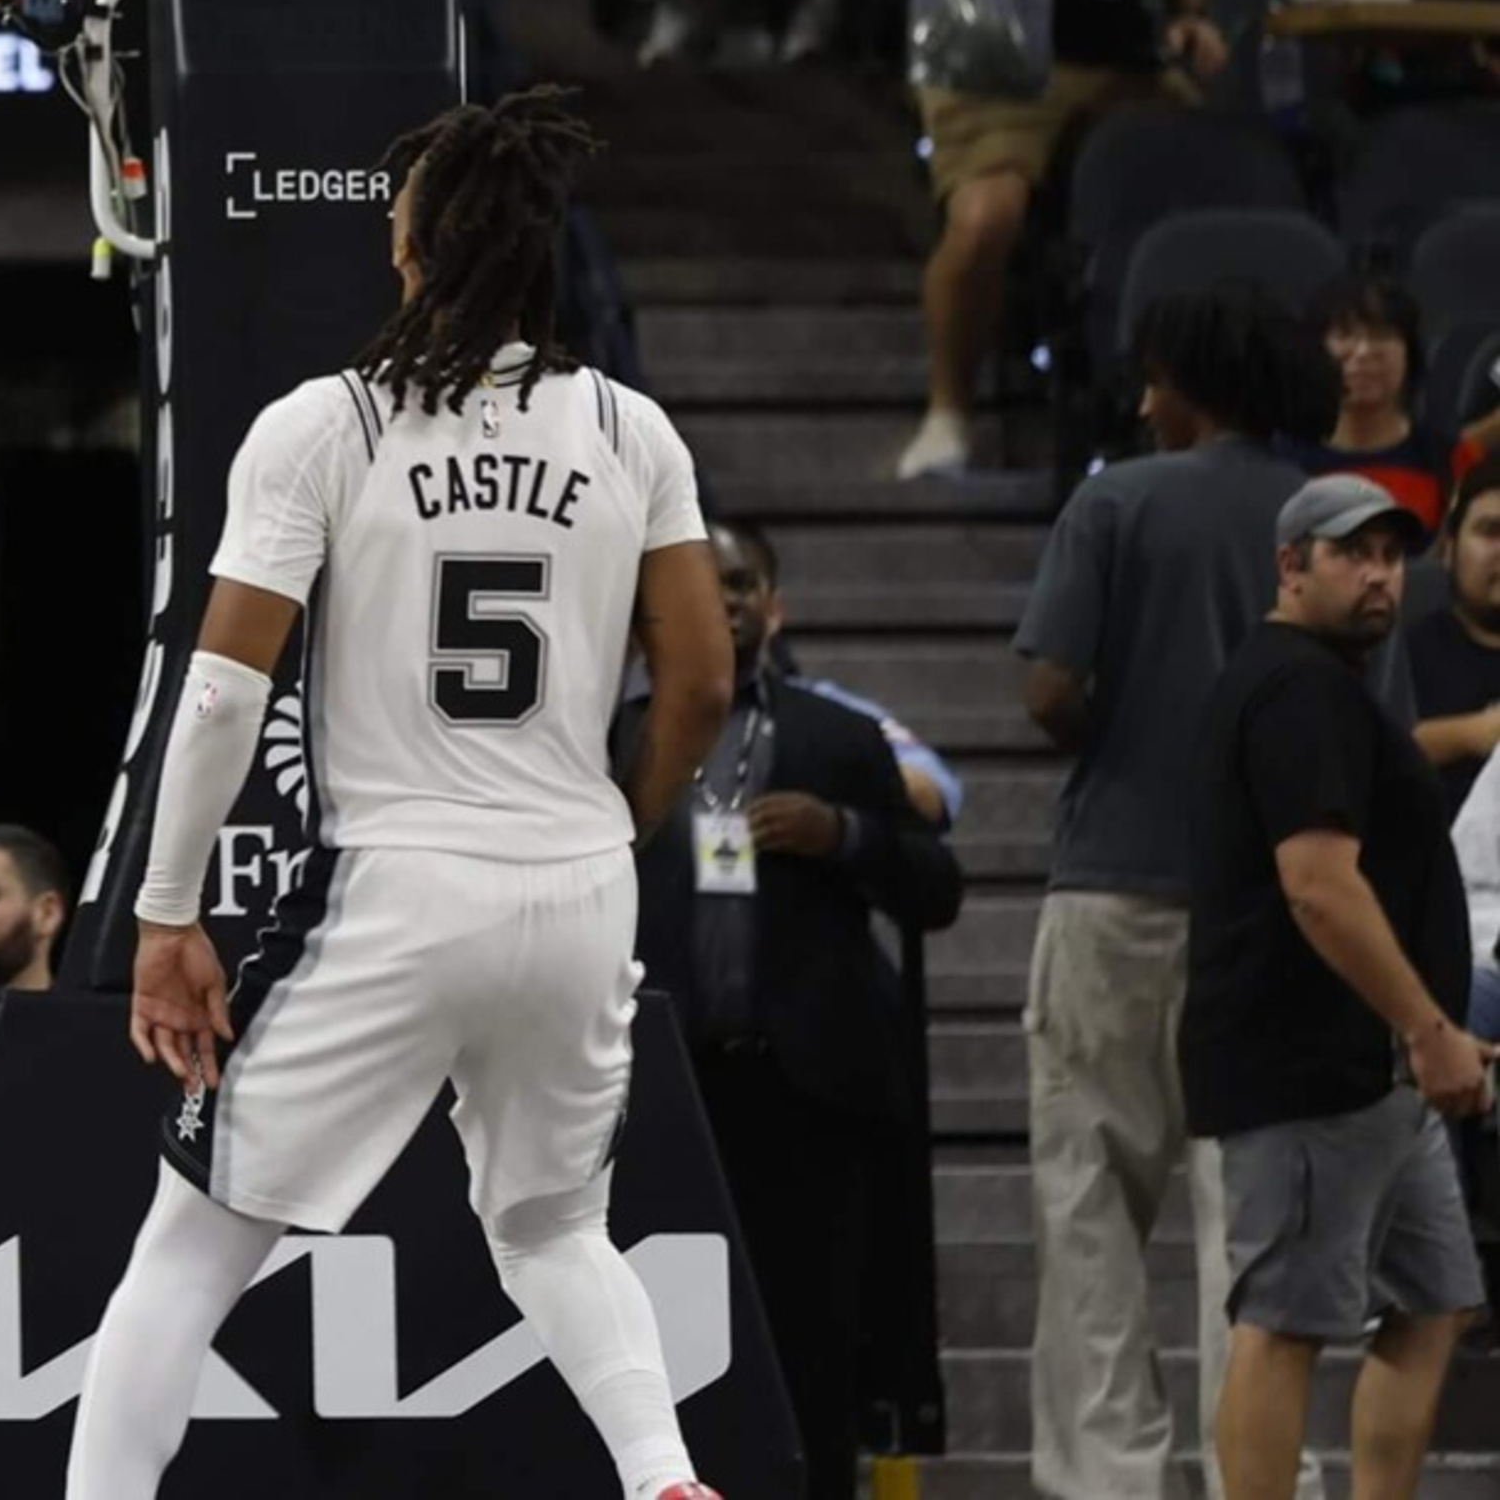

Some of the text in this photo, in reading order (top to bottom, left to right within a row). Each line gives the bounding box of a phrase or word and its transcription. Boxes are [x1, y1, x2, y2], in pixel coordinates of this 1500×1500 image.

[253, 169, 391, 201] LEDGER
[408, 453, 591, 529] CASTLE
[426, 551, 553, 729] 5
